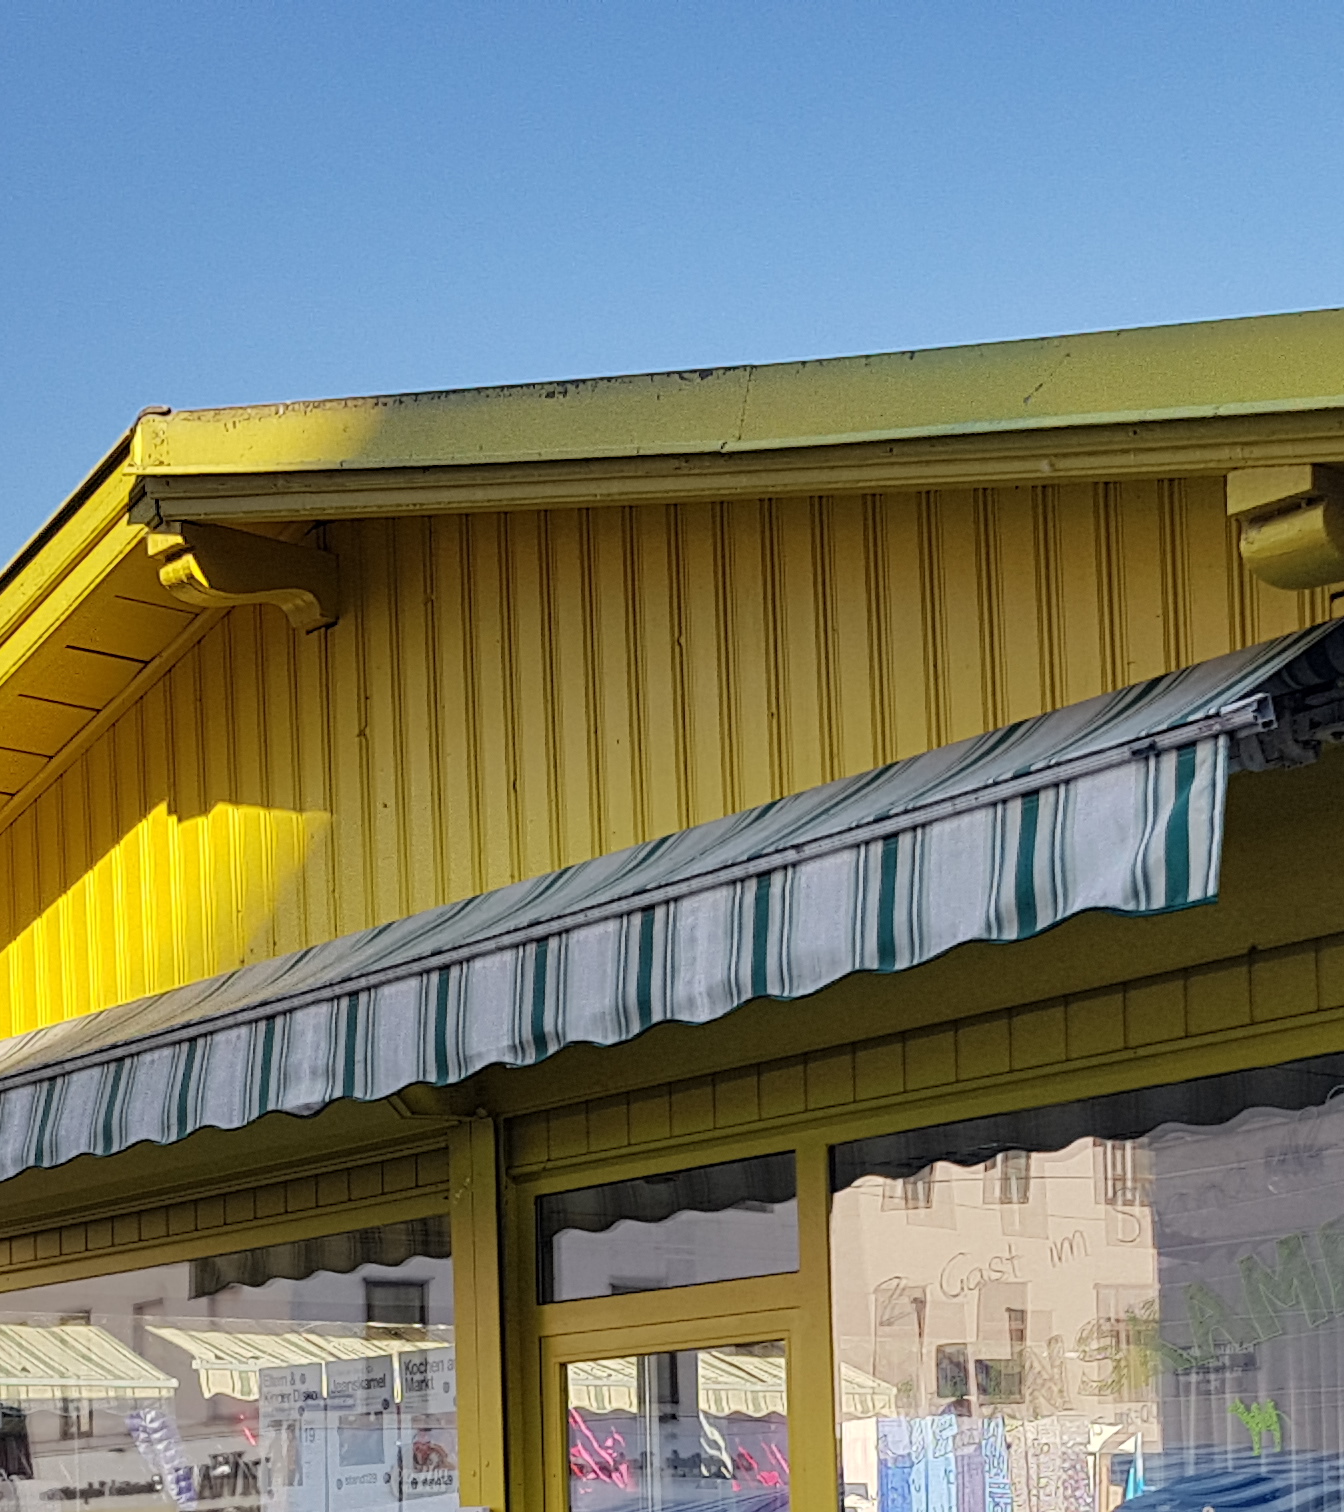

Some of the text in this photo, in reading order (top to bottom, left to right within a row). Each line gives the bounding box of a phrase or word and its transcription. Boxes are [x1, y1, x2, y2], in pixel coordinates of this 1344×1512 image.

[1050, 1230, 1091, 1269] im
[404, 1356, 444, 1376] Kochen
[405, 1375, 435, 1394] Markt
